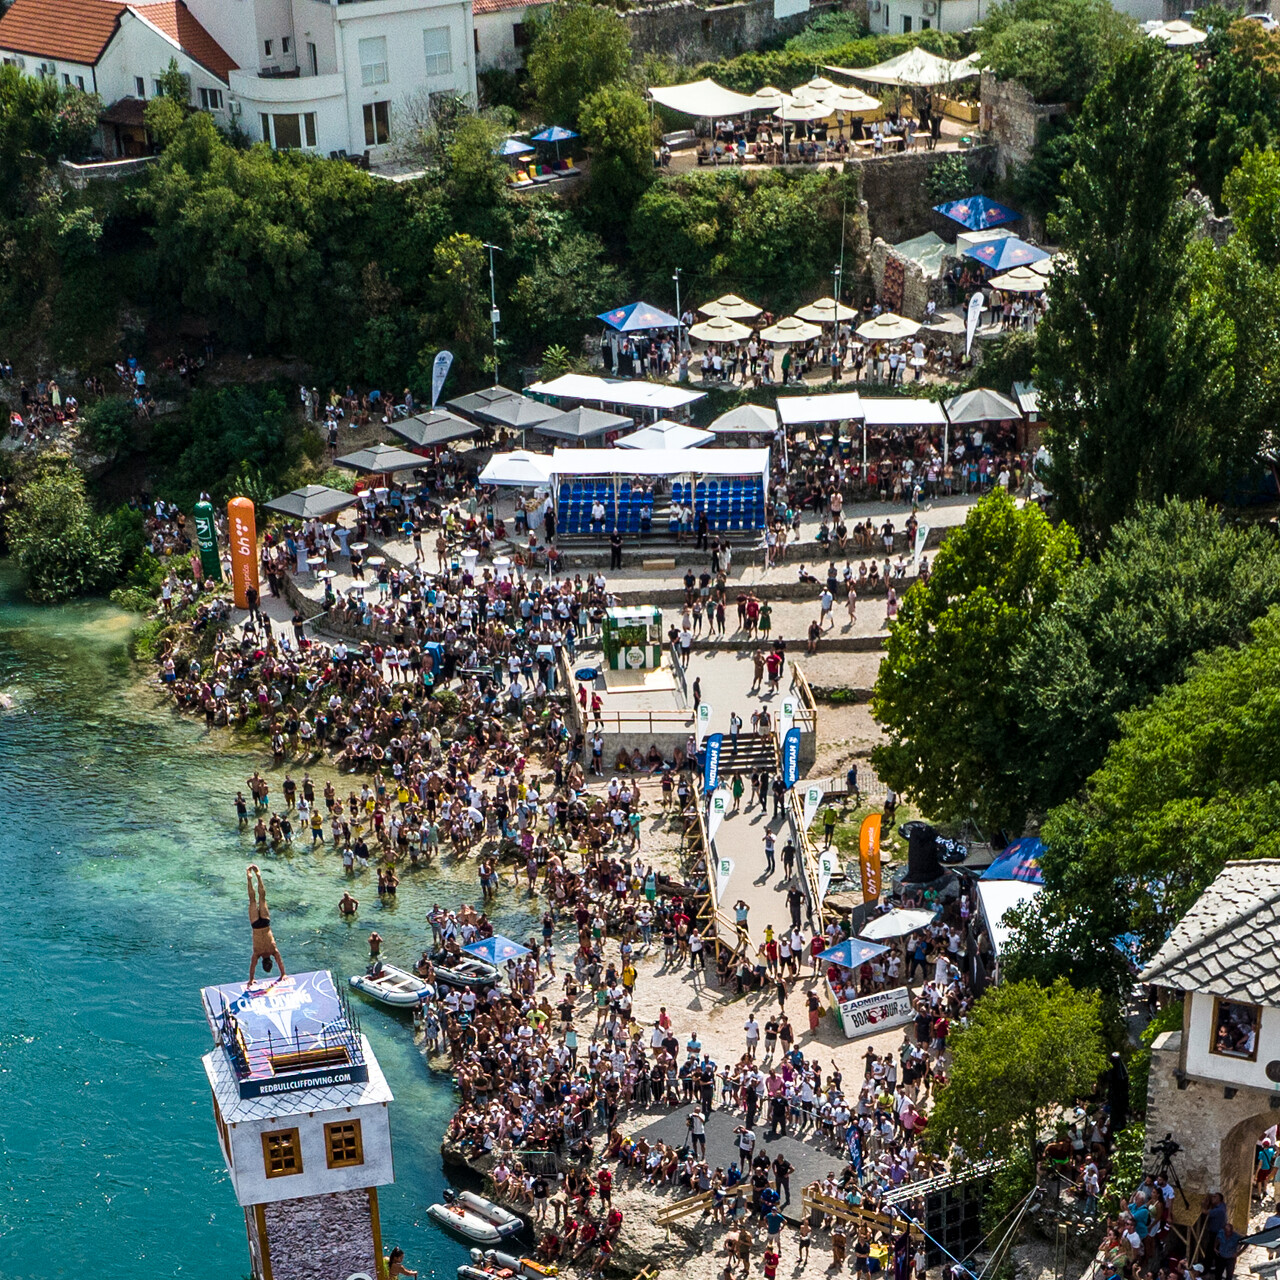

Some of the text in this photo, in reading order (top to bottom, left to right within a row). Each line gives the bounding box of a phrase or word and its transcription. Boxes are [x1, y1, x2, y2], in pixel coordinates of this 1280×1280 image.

[788, 745, 797, 782] HYUNDAI
[850, 993, 893, 1010] ADMIRAL
[259, 1073, 351, 1094] REDBULLCLIFFDIVING.COM
